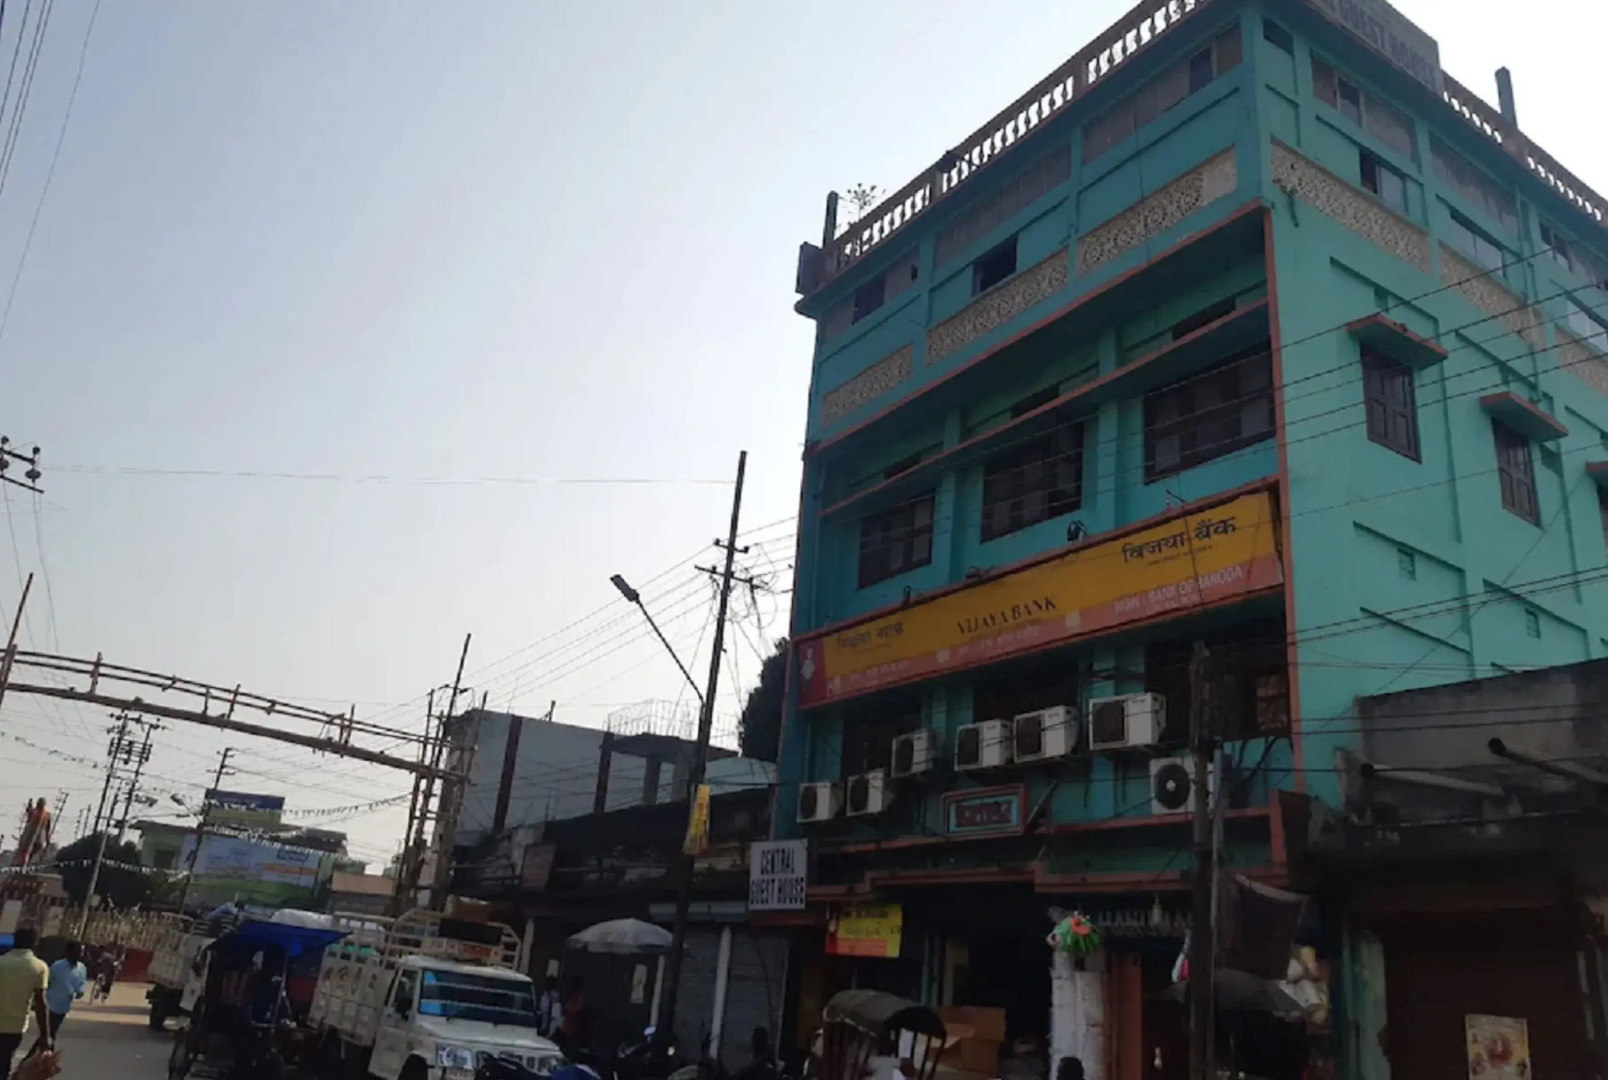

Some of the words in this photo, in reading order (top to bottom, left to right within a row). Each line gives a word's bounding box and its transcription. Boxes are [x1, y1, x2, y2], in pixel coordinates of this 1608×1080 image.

[1194, 516, 1236, 542] बैंक
[1147, 584, 1177, 604] BANK
[956, 610, 1008, 635] VIJAYA
[1011, 596, 1056, 621] BANK
[760, 848, 795, 875] CENTRAL
[750, 879, 776, 905] GUEST
[778, 877, 805, 905] HOUSE
